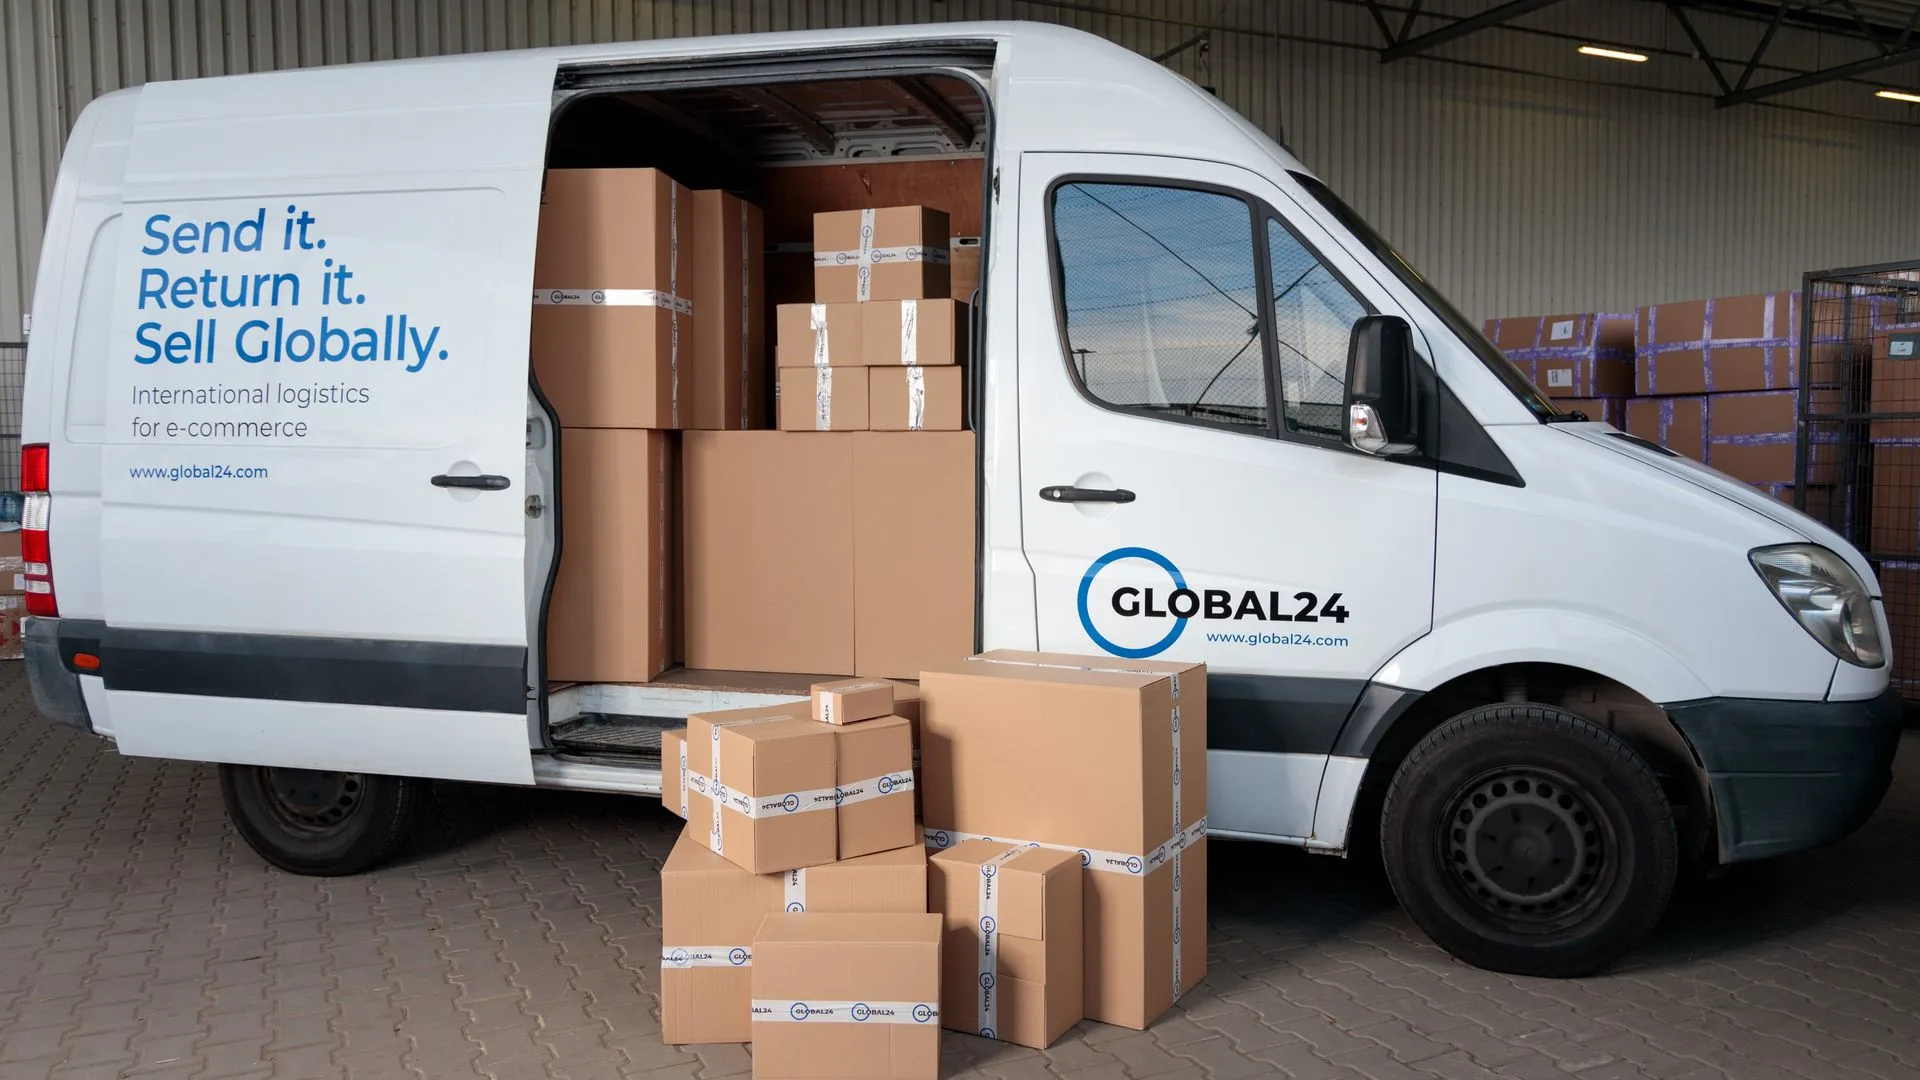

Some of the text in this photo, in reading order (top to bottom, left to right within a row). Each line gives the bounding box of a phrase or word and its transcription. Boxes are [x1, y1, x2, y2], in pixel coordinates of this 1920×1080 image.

[142, 205, 326, 255] Send it.
[138, 258, 365, 309] Return it.
[134, 314, 448, 373] Sell Globally.
[132, 382, 370, 408] International logistics
[132, 417, 307, 438] for e-commerce
[129, 464, 268, 481] www.global24.com
[1111, 586, 1349, 623] GLOBAL24
[1206, 632, 1349, 647] www.global24.com
[762, 800, 795, 809] GLOBAL24
[1106, 858, 1138, 868] GLOBAL24
